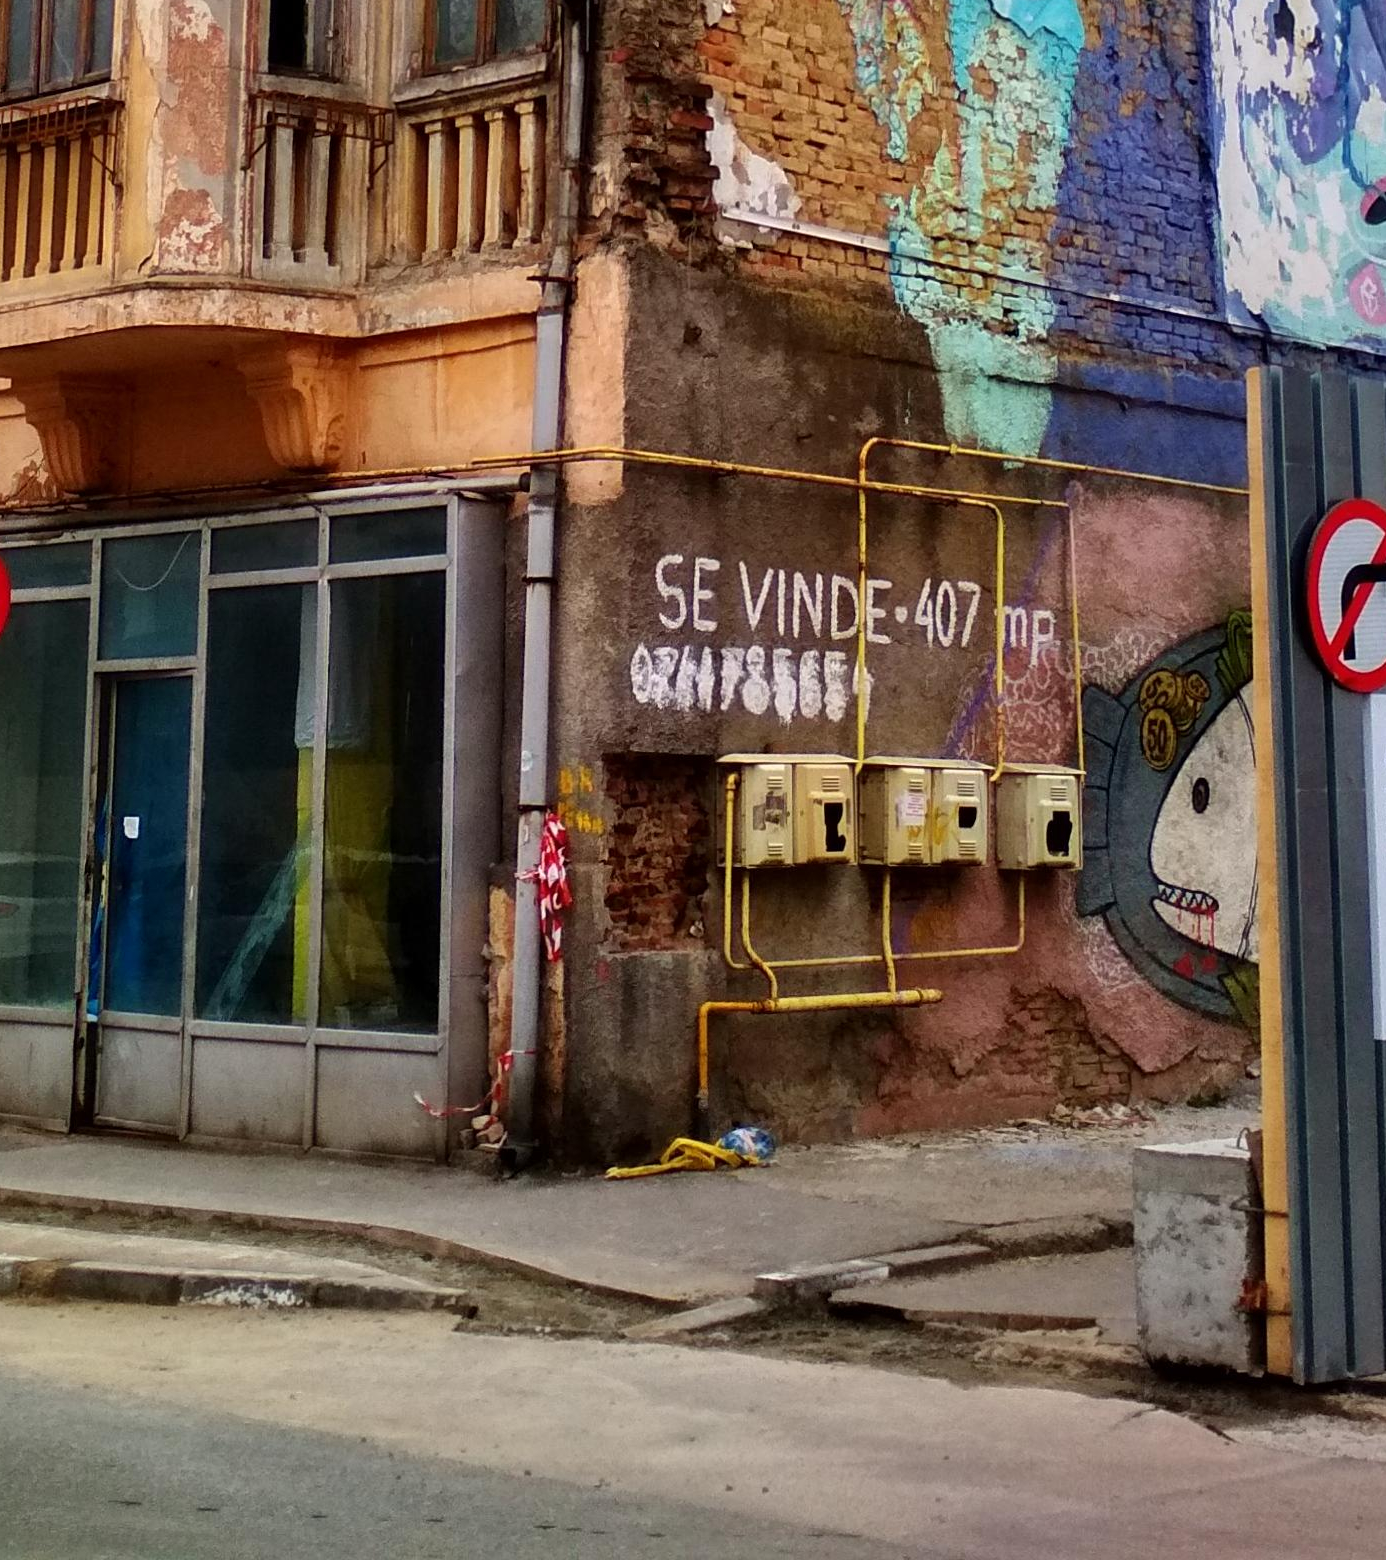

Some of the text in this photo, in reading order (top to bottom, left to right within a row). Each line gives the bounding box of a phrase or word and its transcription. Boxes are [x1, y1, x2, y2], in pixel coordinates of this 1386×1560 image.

[655, 554, 721, 632] SE
[738, 560, 893, 644] VINDE
[914, 577, 981, 648] 407
[1147, 717, 1168, 754] 50
